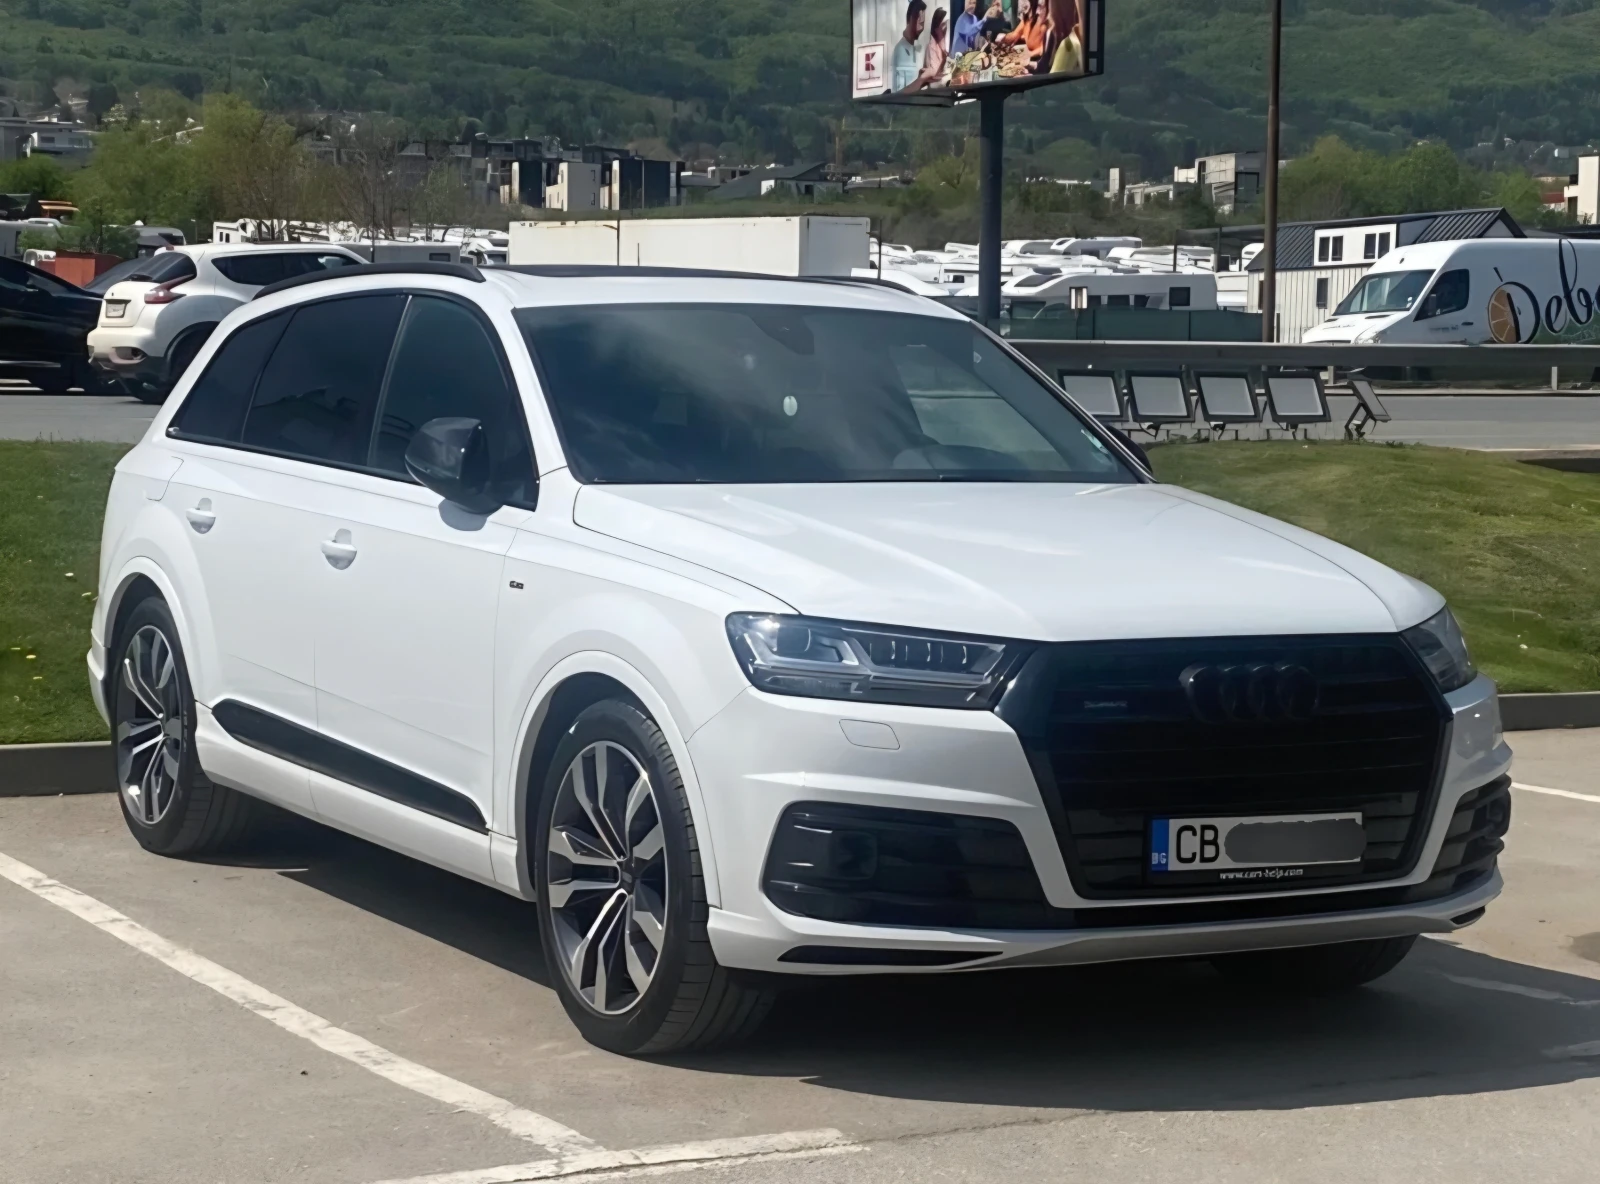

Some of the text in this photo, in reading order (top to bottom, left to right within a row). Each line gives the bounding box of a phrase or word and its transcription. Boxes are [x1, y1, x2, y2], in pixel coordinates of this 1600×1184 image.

[865, 52, 876, 71] K
[1488, 238, 1600, 344] Deb
[1151, 824, 1220, 865] BG CB
